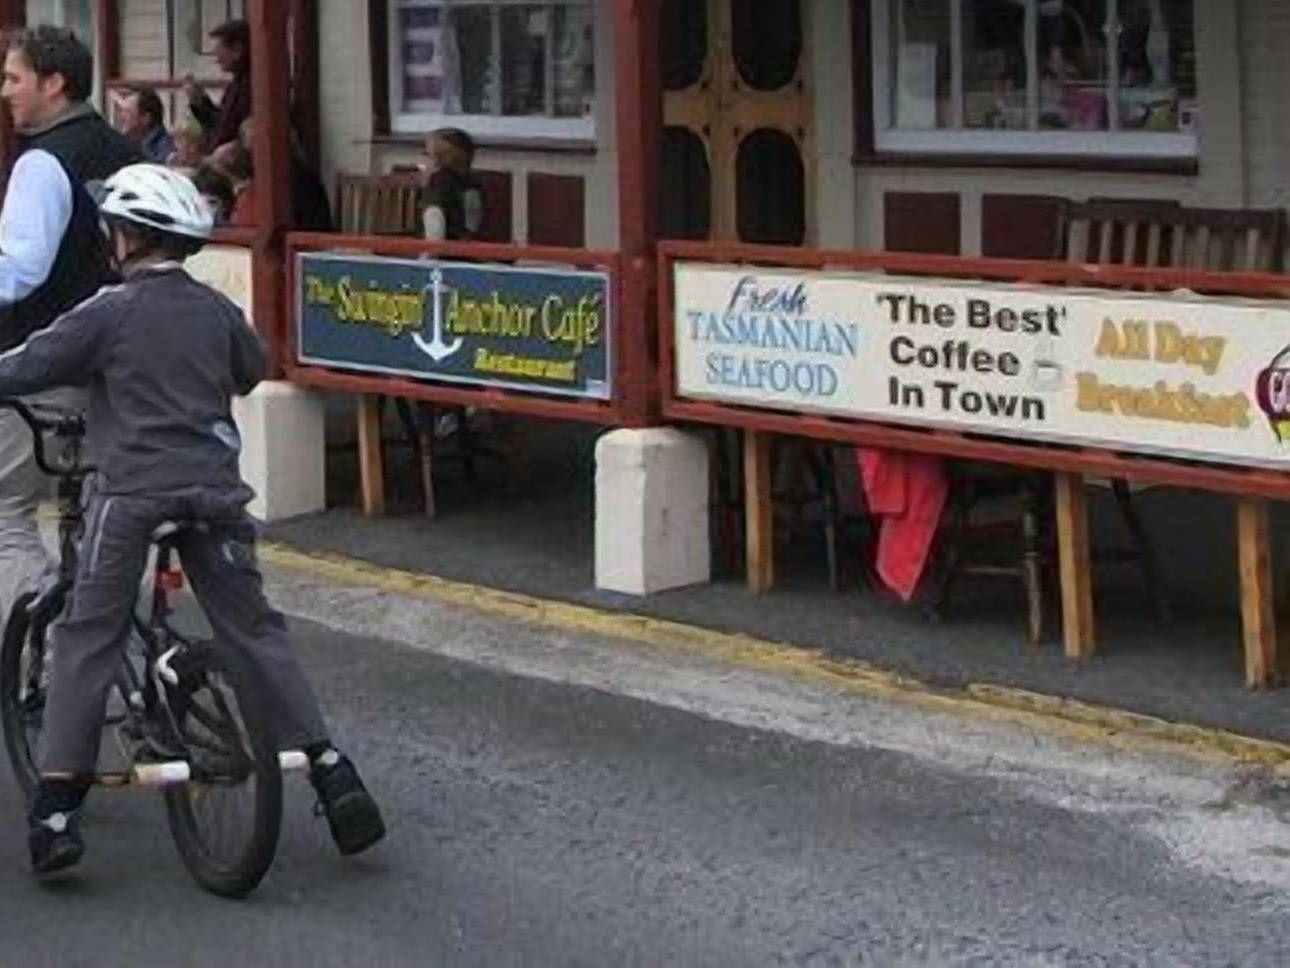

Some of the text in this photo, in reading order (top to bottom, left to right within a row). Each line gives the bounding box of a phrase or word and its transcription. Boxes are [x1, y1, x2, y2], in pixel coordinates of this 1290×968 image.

[726, 275, 807, 317] Fresh
[686, 311, 858, 357] TASMANIAN
[889, 335, 1020, 377] Coffee
[705, 352, 839, 396] SEAFOOD
[888, 376, 1046, 420] In Town
